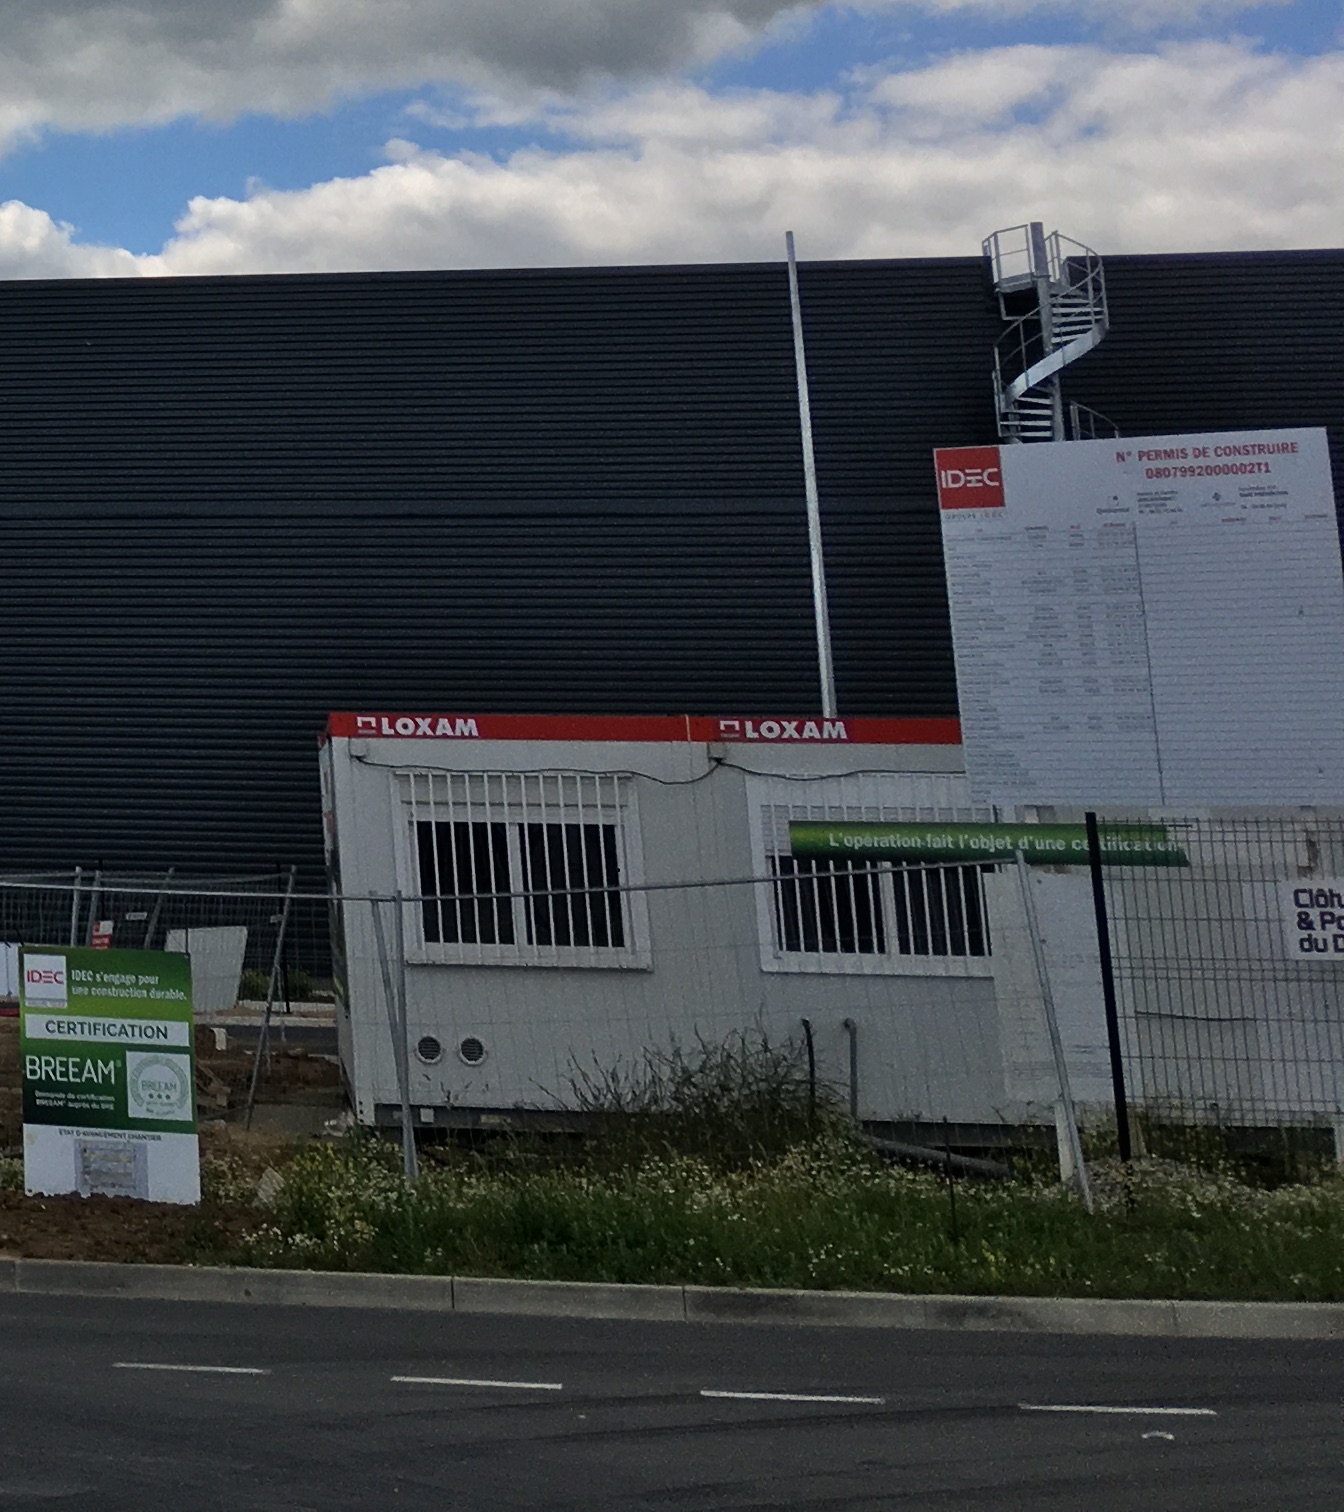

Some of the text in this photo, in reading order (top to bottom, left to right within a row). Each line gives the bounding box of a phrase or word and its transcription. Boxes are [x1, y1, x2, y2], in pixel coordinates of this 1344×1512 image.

[1116, 441, 1299, 464] N° PERMIS DE CONSTRUIRE
[940, 467, 1001, 489] IDEC
[381, 717, 479, 738] LOXAM
[745, 720, 848, 740] LOXAM
[927, 833, 954, 849] fait
[959, 834, 1013, 853] l'objet
[1018, 835, 1066, 851] d'une
[1071, 835, 1179, 852] cetification
[1296, 910, 1316, 931] &
[1299, 933, 1329, 953] du
[26, 969, 65, 985] IDEC
[71, 969, 94, 983] IDEC
[138, 975, 160, 986] pour
[91, 986, 147, 999] construction
[45, 1019, 169, 1040] CERTIFICATION
